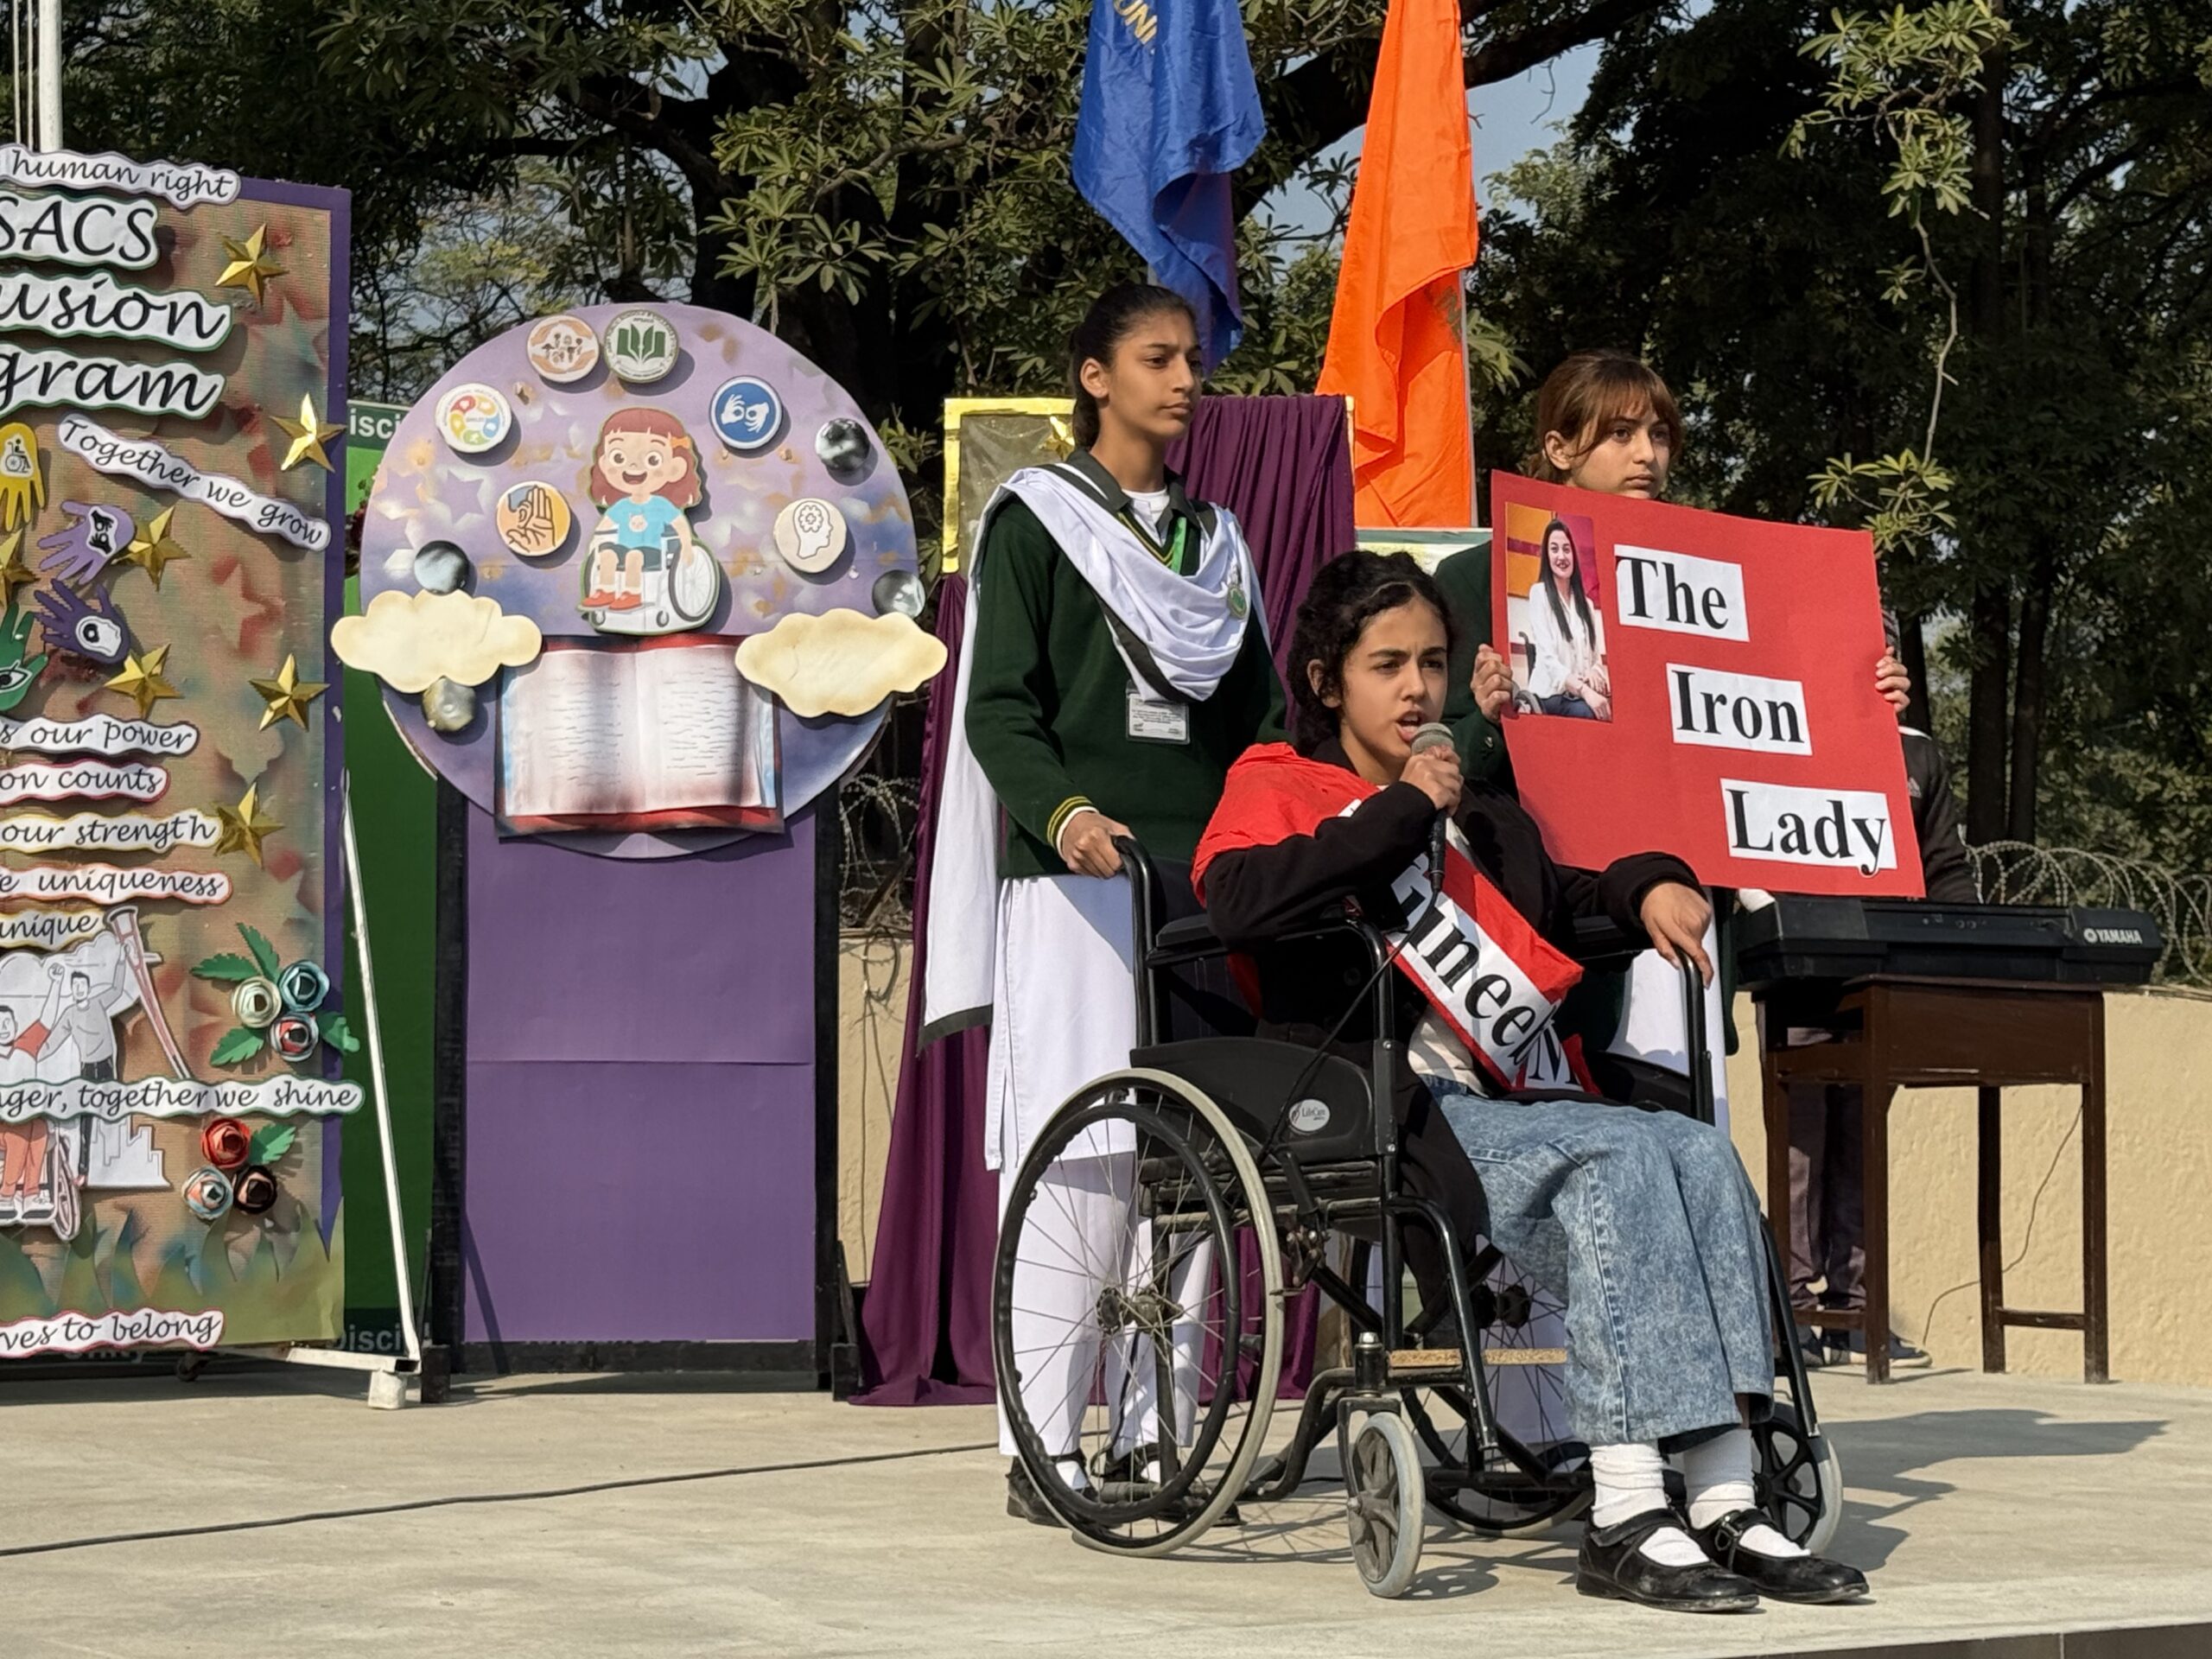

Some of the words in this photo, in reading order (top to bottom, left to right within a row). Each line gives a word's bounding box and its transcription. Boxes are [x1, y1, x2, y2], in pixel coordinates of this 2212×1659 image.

[12, 149, 140, 185] human
[149, 164, 233, 201] right
[62, 418, 200, 489] Together
[207, 480, 251, 508] we
[261, 501, 322, 545] grow
[1615, 554, 1729, 631] The
[1671, 669, 1805, 745] Iron
[30, 727, 93, 745] our
[103, 720, 193, 749] power
[58, 767, 163, 794] counts
[2, 824, 67, 843] our
[74, 815, 217, 849] strength
[1725, 788, 1887, 877] Lady
[38, 869, 225, 899] uniqueness
[2095, 929, 2143, 944] YAMAHA
[77, 1080, 207, 1115] together
[215, 1090, 261, 1107] we
[273, 1074, 359, 1107] shine
[62, 1317, 102, 1341] to
[111, 1311, 221, 1343] belong
